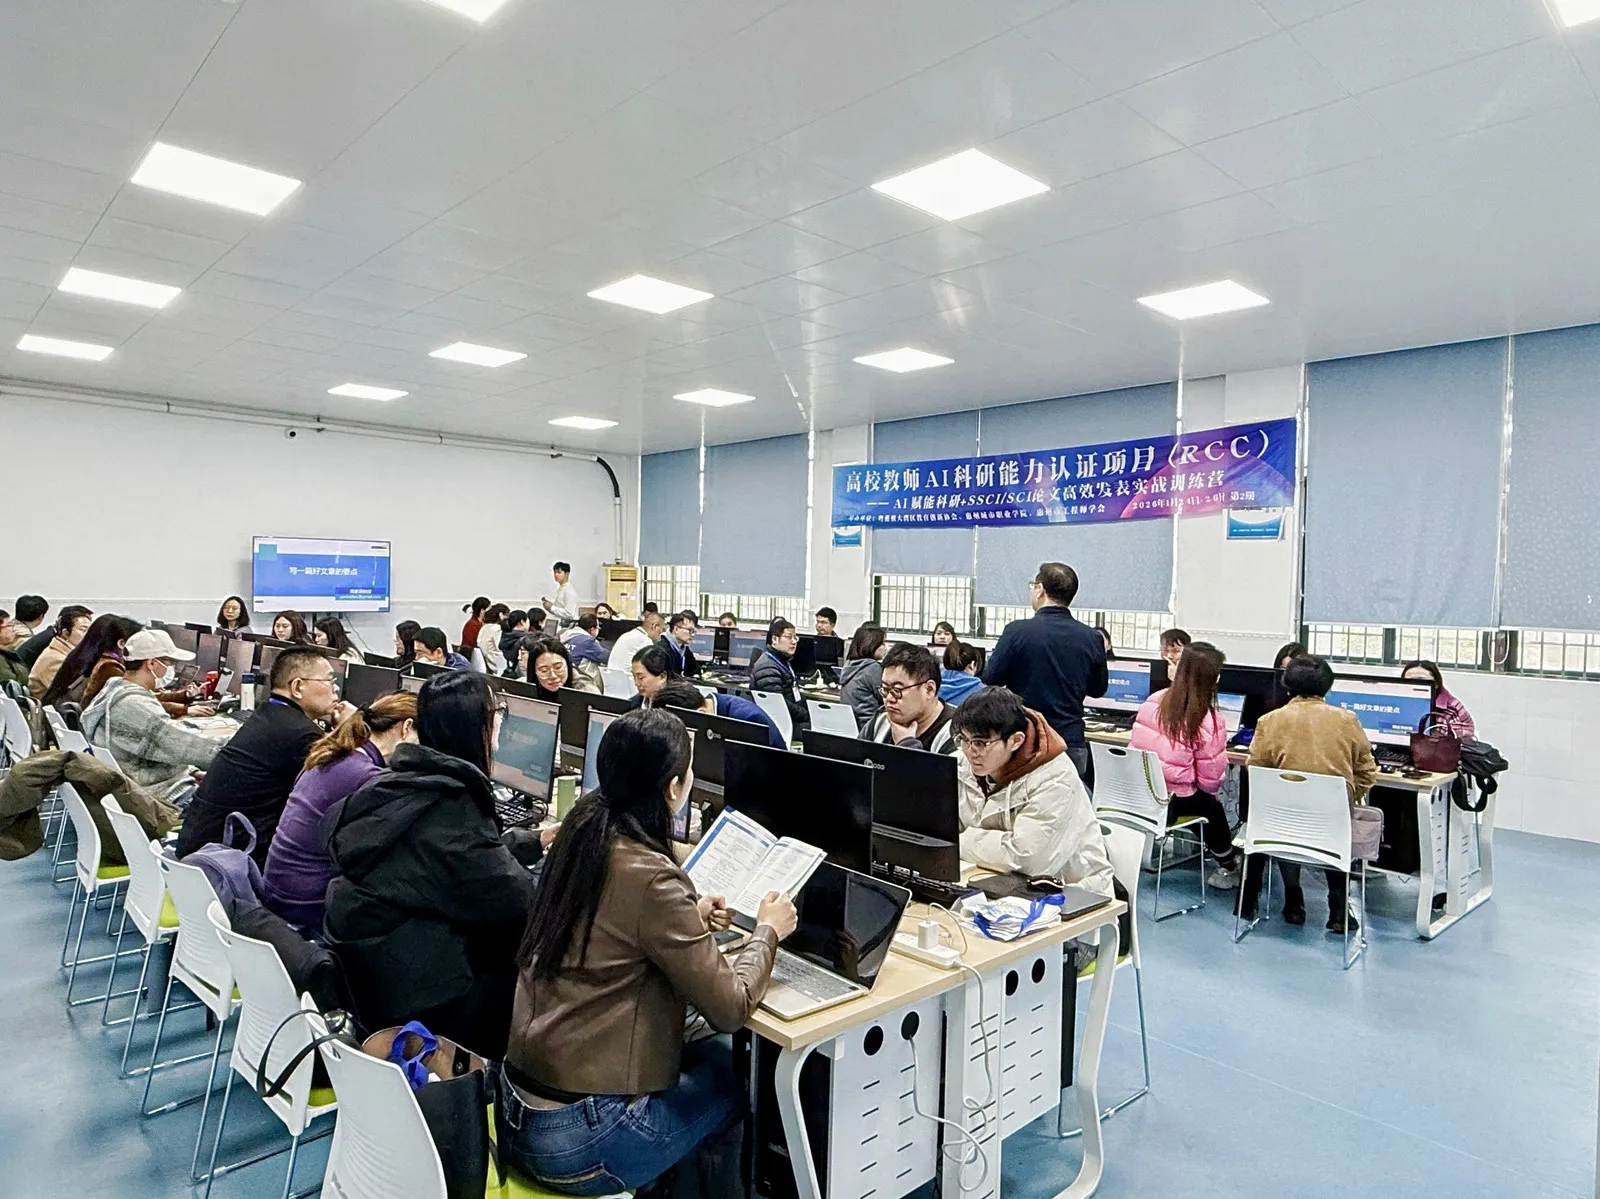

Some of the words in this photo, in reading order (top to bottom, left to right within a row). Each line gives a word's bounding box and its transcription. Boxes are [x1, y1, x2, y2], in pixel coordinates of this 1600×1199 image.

[289, 566, 358, 576] 写一篇好文章的要点
[1340, 702, 1400, 714] 写一篇好文章的要点
